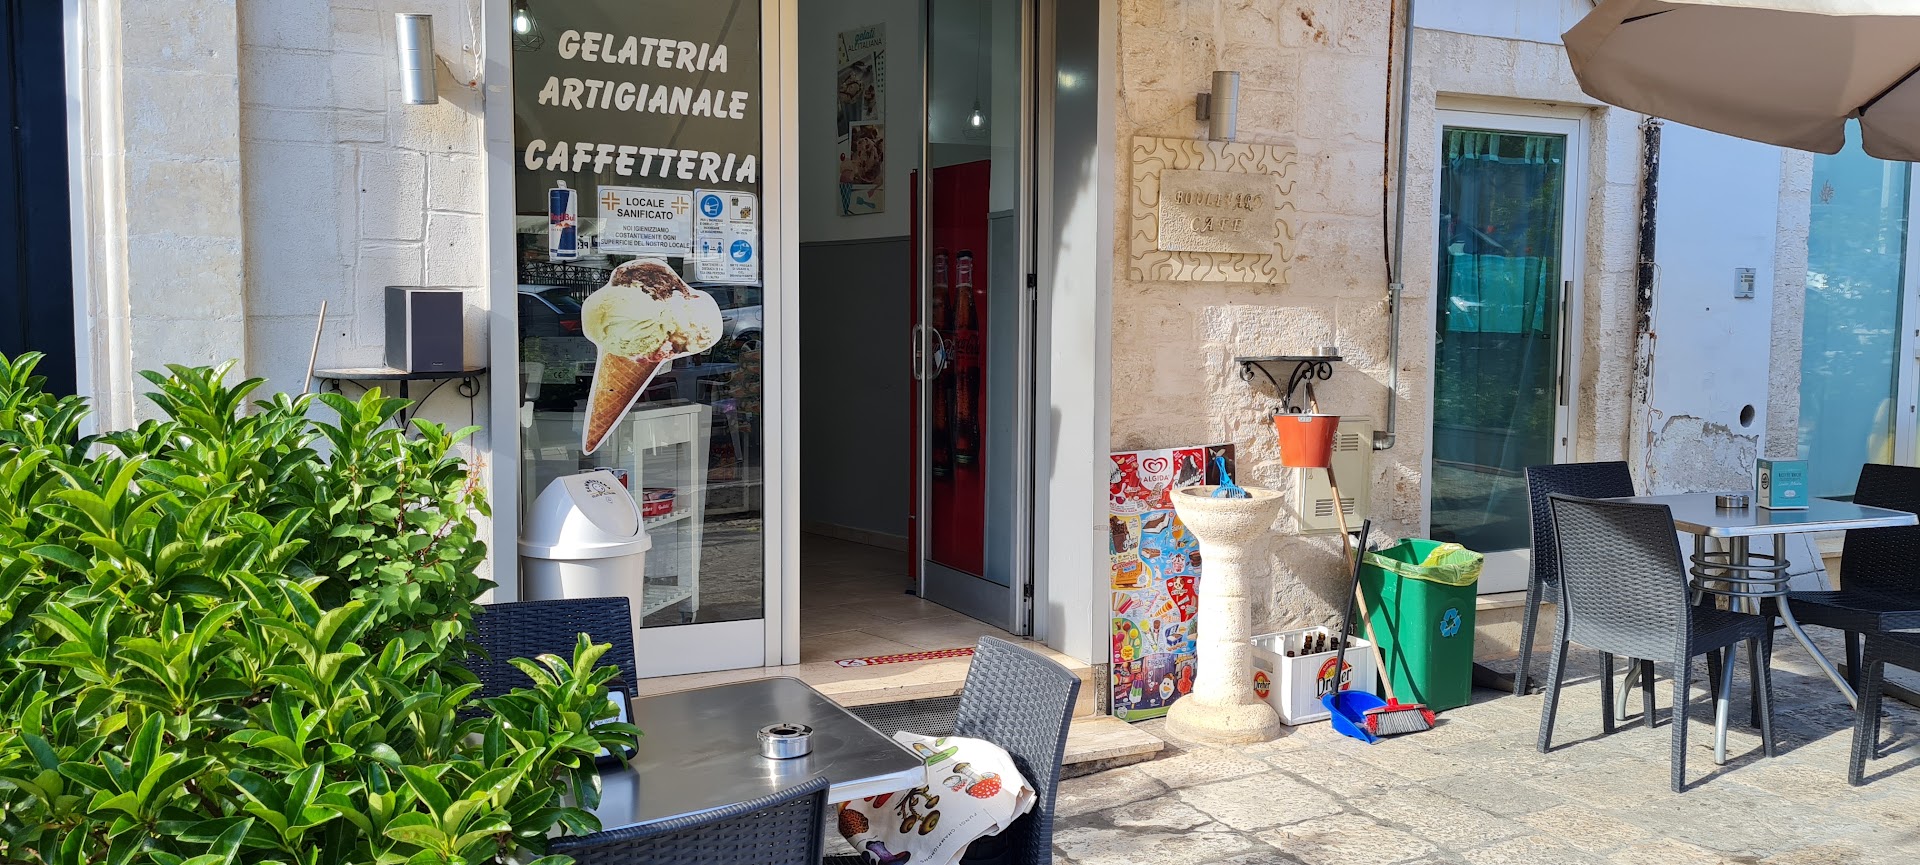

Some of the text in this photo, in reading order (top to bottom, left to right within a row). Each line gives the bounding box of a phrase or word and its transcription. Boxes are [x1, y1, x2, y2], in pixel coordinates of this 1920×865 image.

[558, 29, 728, 73] GELATERIA
[538, 76, 749, 119] ARTIGIANALE
[524, 139, 757, 184] CAFFETTERIA
[626, 197, 665, 208] LOCALE
[617, 208, 674, 220] SANIFICATO
[1190, 217, 1244, 233] CAFE
[615, 232, 662, 241] COSTANTEMENTE
[645, 240, 669, 248] NOSTRO
[1143, 475, 1169, 483] ALGIDA
